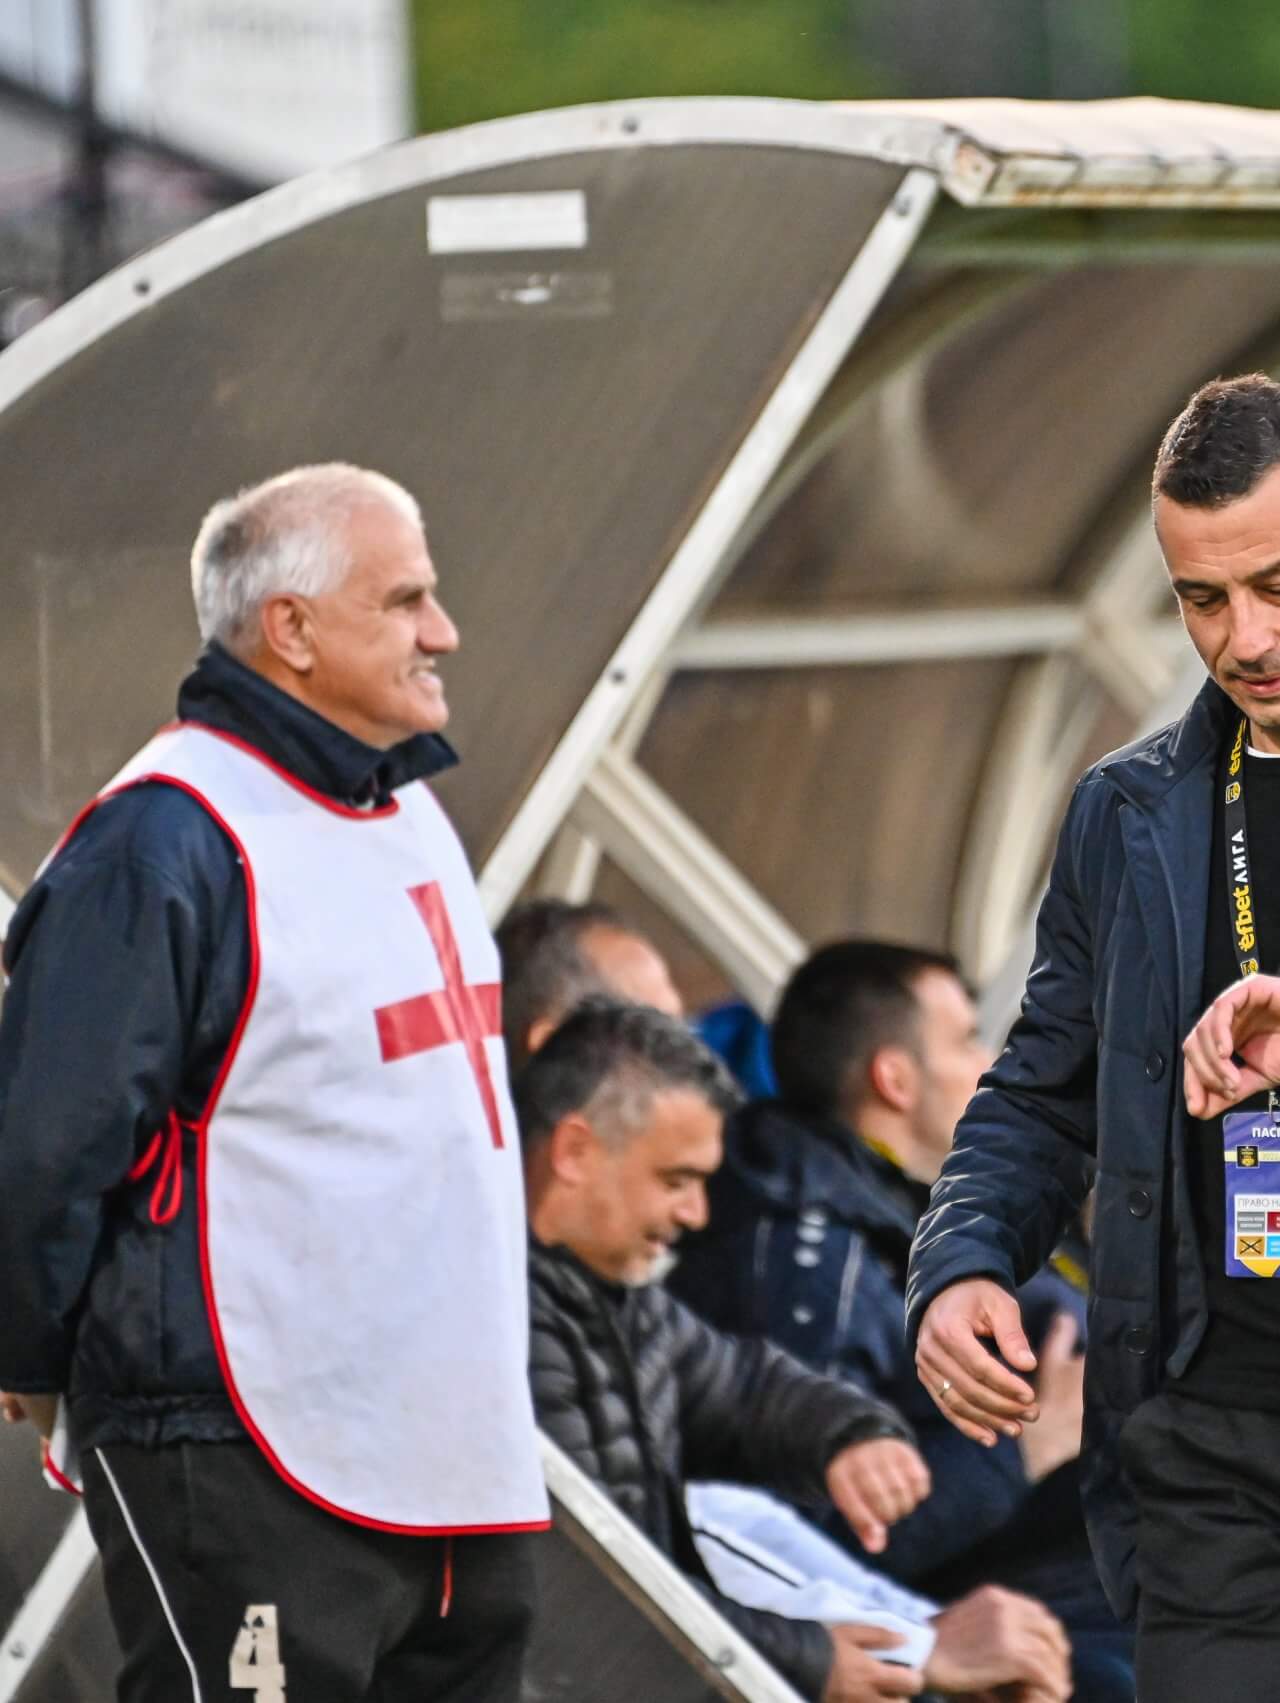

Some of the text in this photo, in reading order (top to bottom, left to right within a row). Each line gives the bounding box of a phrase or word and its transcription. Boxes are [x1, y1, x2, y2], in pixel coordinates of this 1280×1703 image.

[1232, 884, 1255, 952] efbet
[1238, 1198, 1270, 1208] ПРАВО
[229, 1604, 286, 1703] 4
